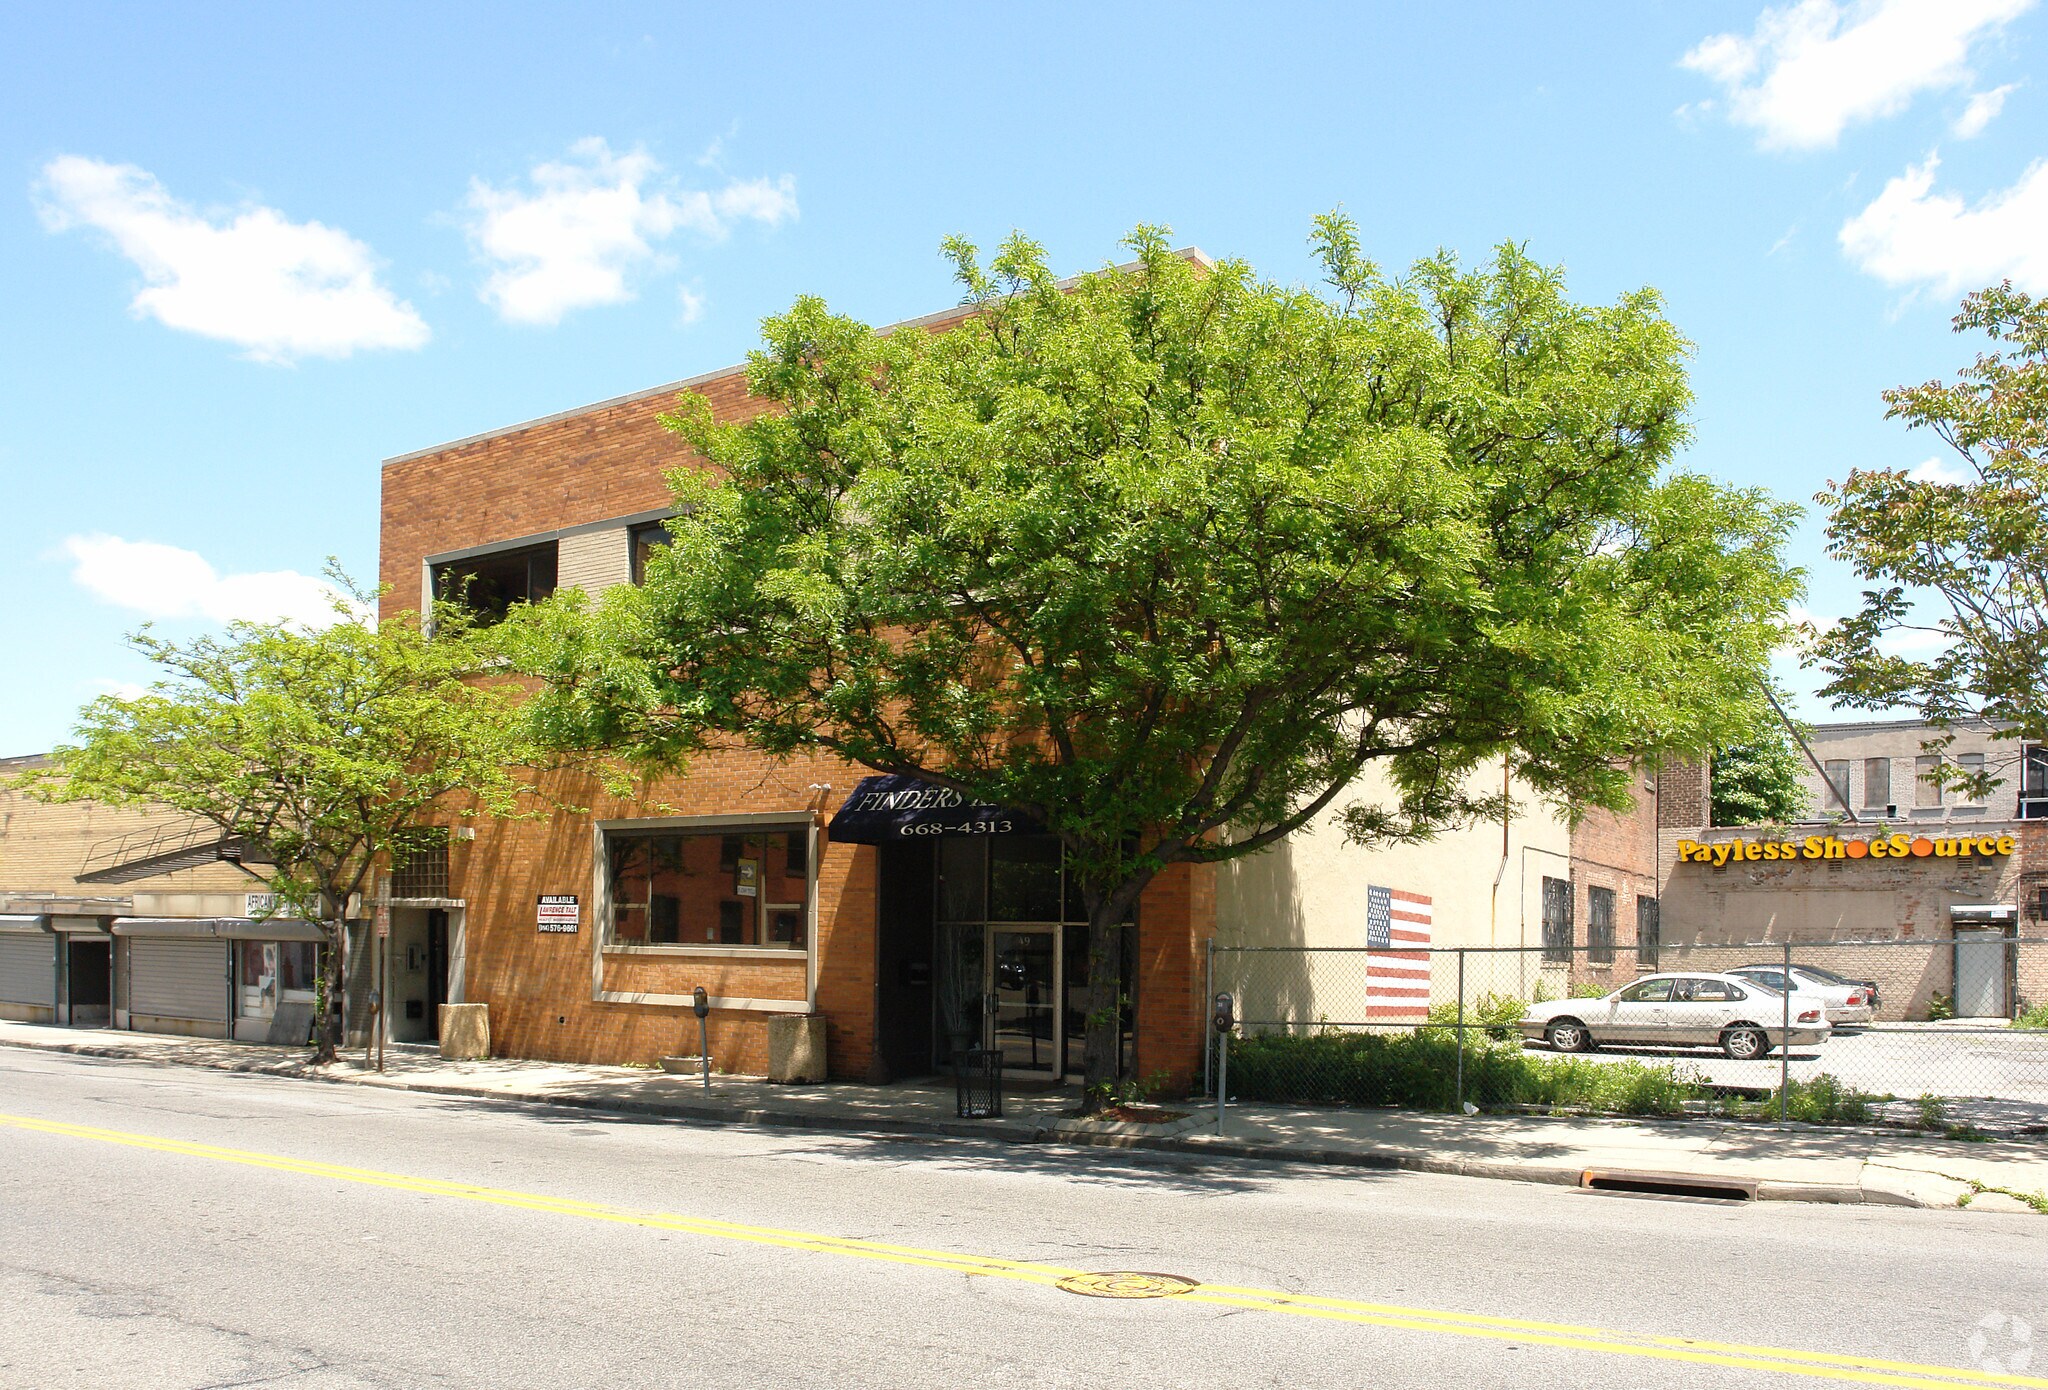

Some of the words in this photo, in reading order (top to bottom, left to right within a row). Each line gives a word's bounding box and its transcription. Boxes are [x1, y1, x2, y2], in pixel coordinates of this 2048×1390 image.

[855, 787, 962, 811] FINDERS
[900, 820, 1013, 836] 668-4313
[1677, 838, 1797, 866] Payless
[1802, 834, 2016, 859] ShoeSource
